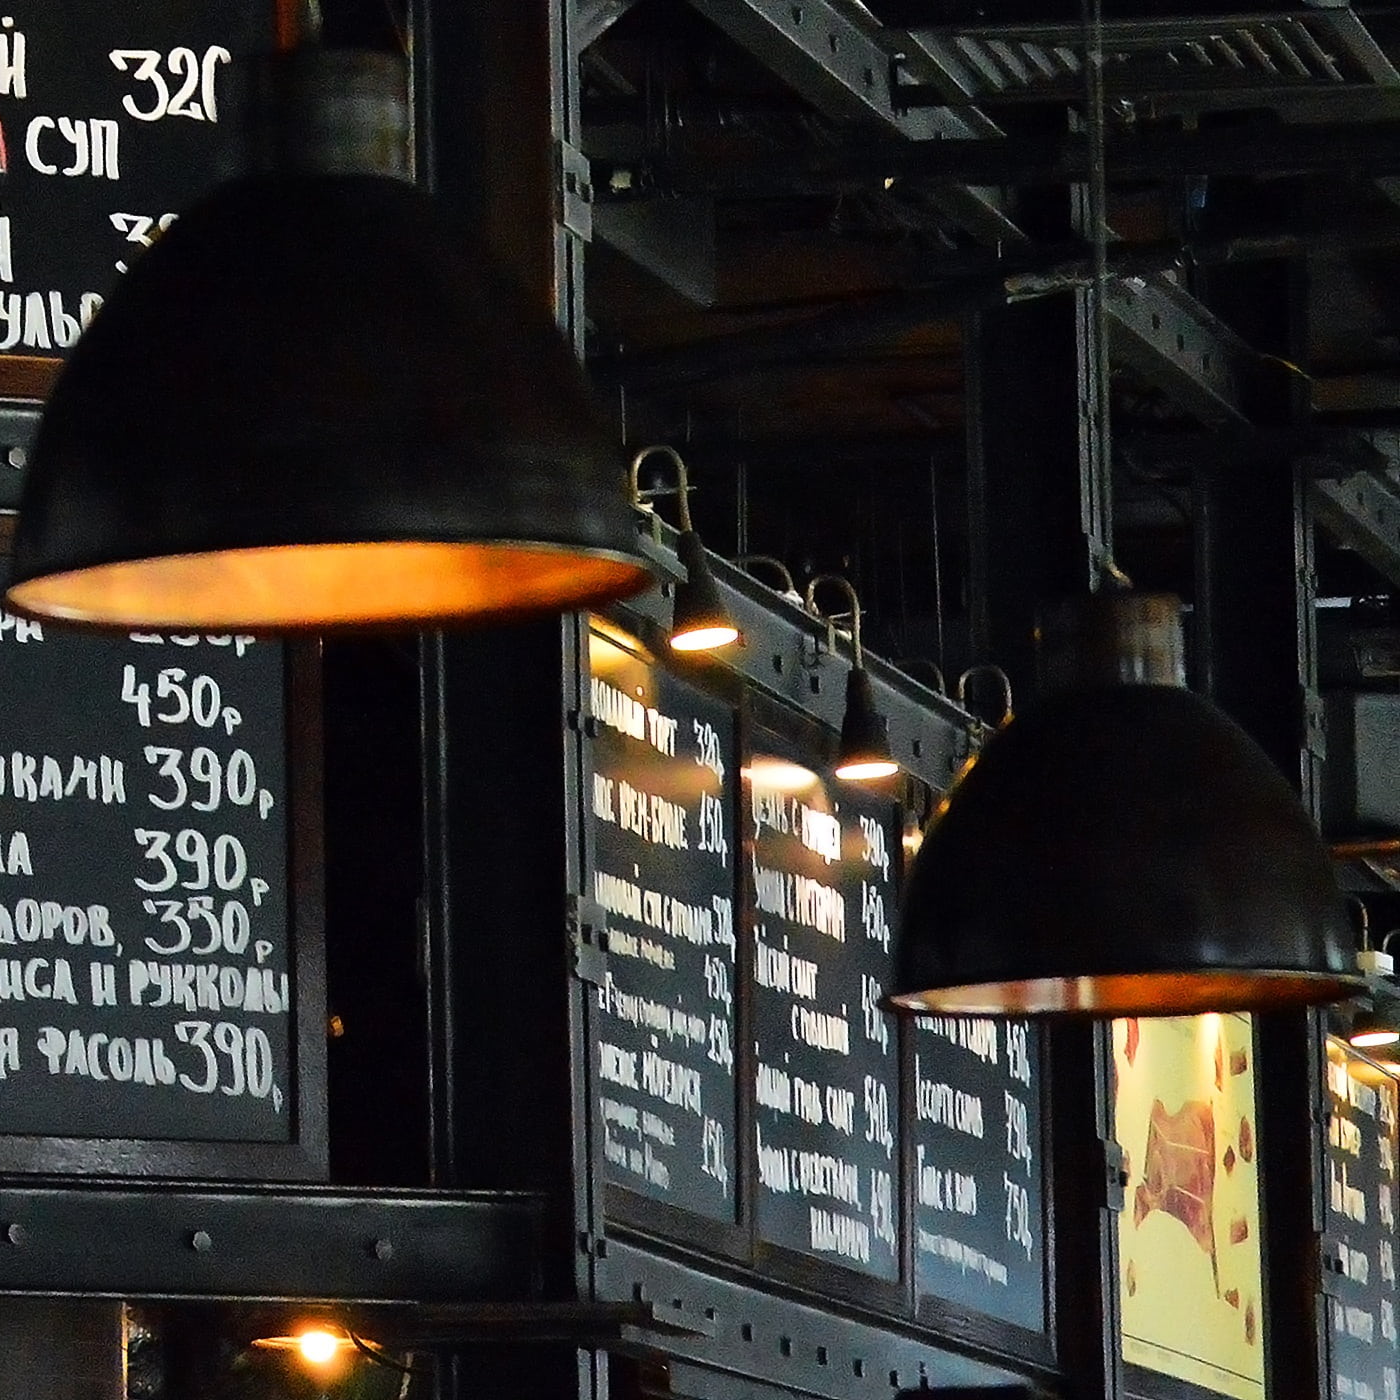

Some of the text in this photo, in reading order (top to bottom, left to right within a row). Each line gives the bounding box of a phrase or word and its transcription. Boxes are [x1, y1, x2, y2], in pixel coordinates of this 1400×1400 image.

[26, 116, 119, 180] СУП
[122, 665, 242, 735] 450р
[144, 745, 274, 820] 390р
[134, 828, 269, 907] 390р
[143, 896, 273, 963] 350р
[90, 962, 117, 1006] И
[129, 959, 289, 1013] РУККОЛЫ
[37, 1026, 176, 1085] ФАСОЛЬ
